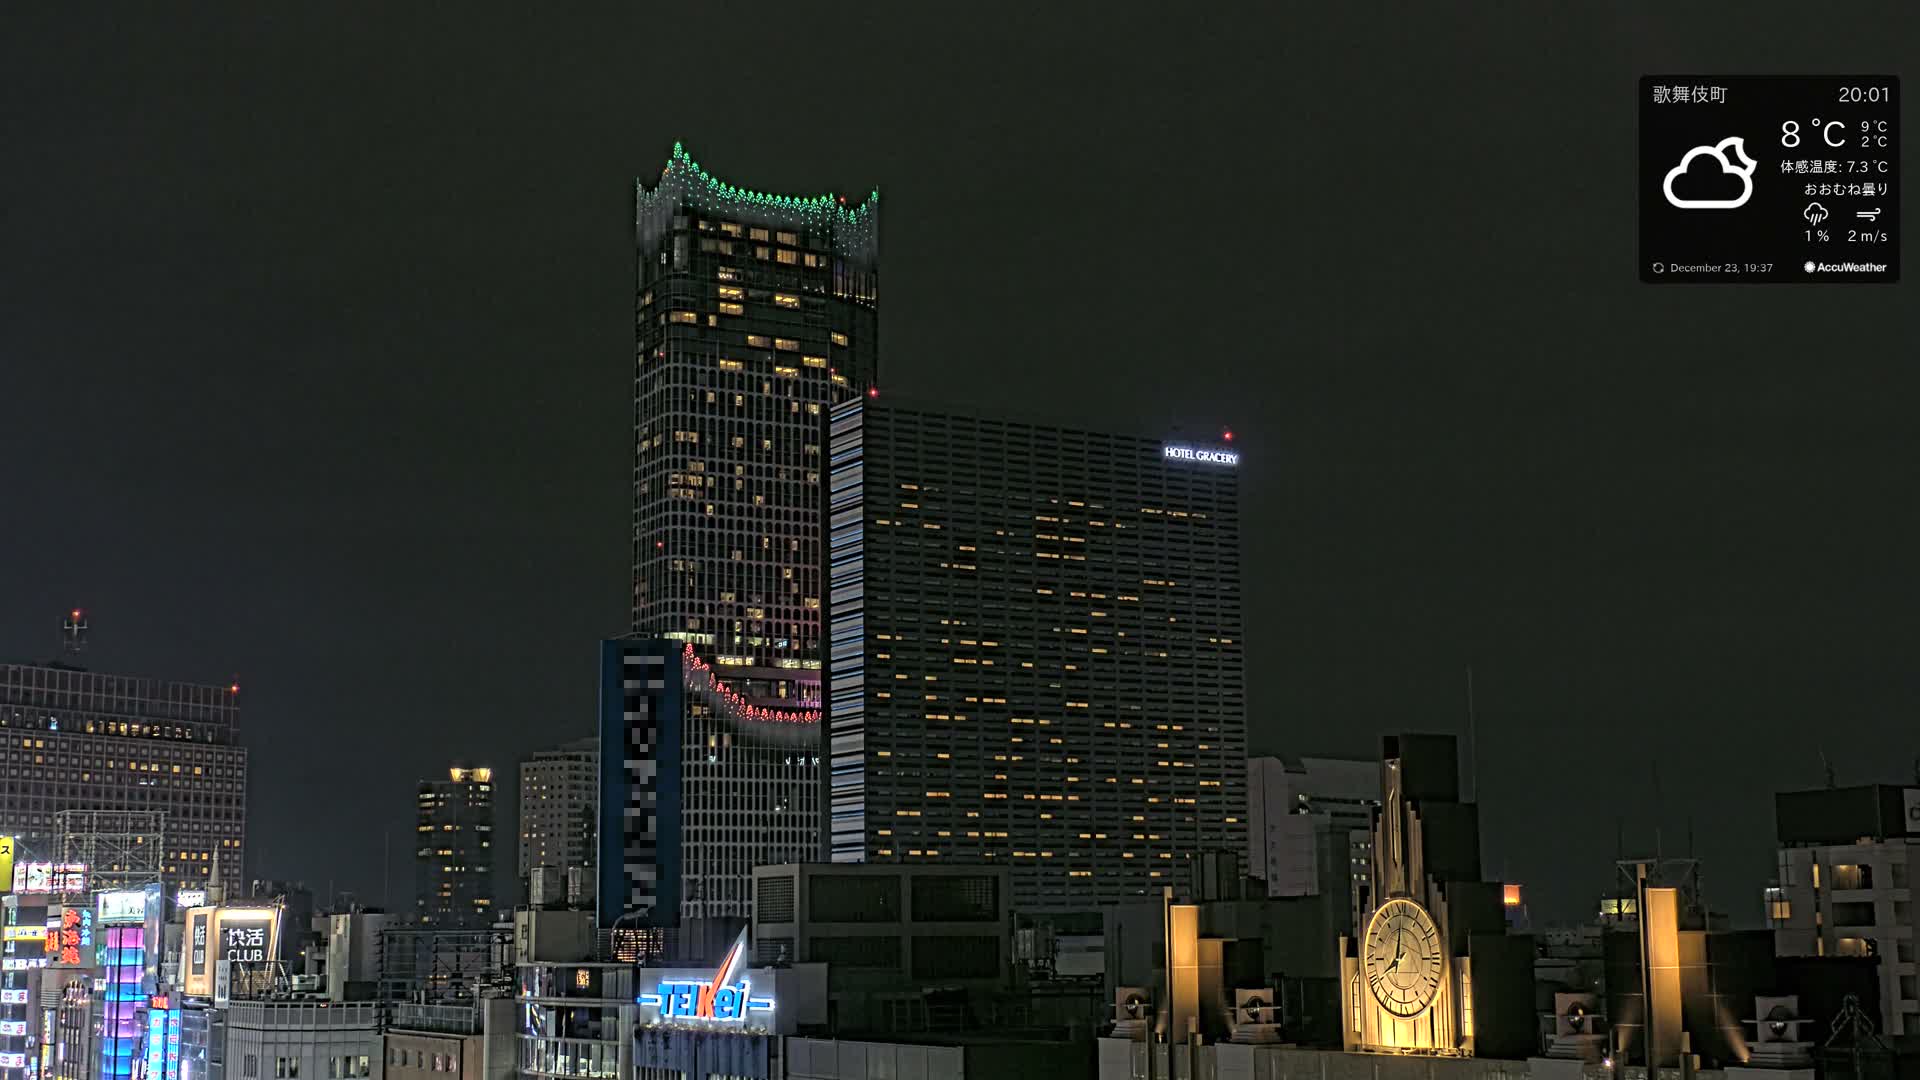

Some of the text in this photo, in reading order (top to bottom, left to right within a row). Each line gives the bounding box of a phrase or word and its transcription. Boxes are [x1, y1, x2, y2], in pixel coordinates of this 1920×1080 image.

[1165, 446, 1238, 464] HOTEL GRACERY
[227, 928, 264, 947] 快活
[227, 949, 263, 962] CLUB
